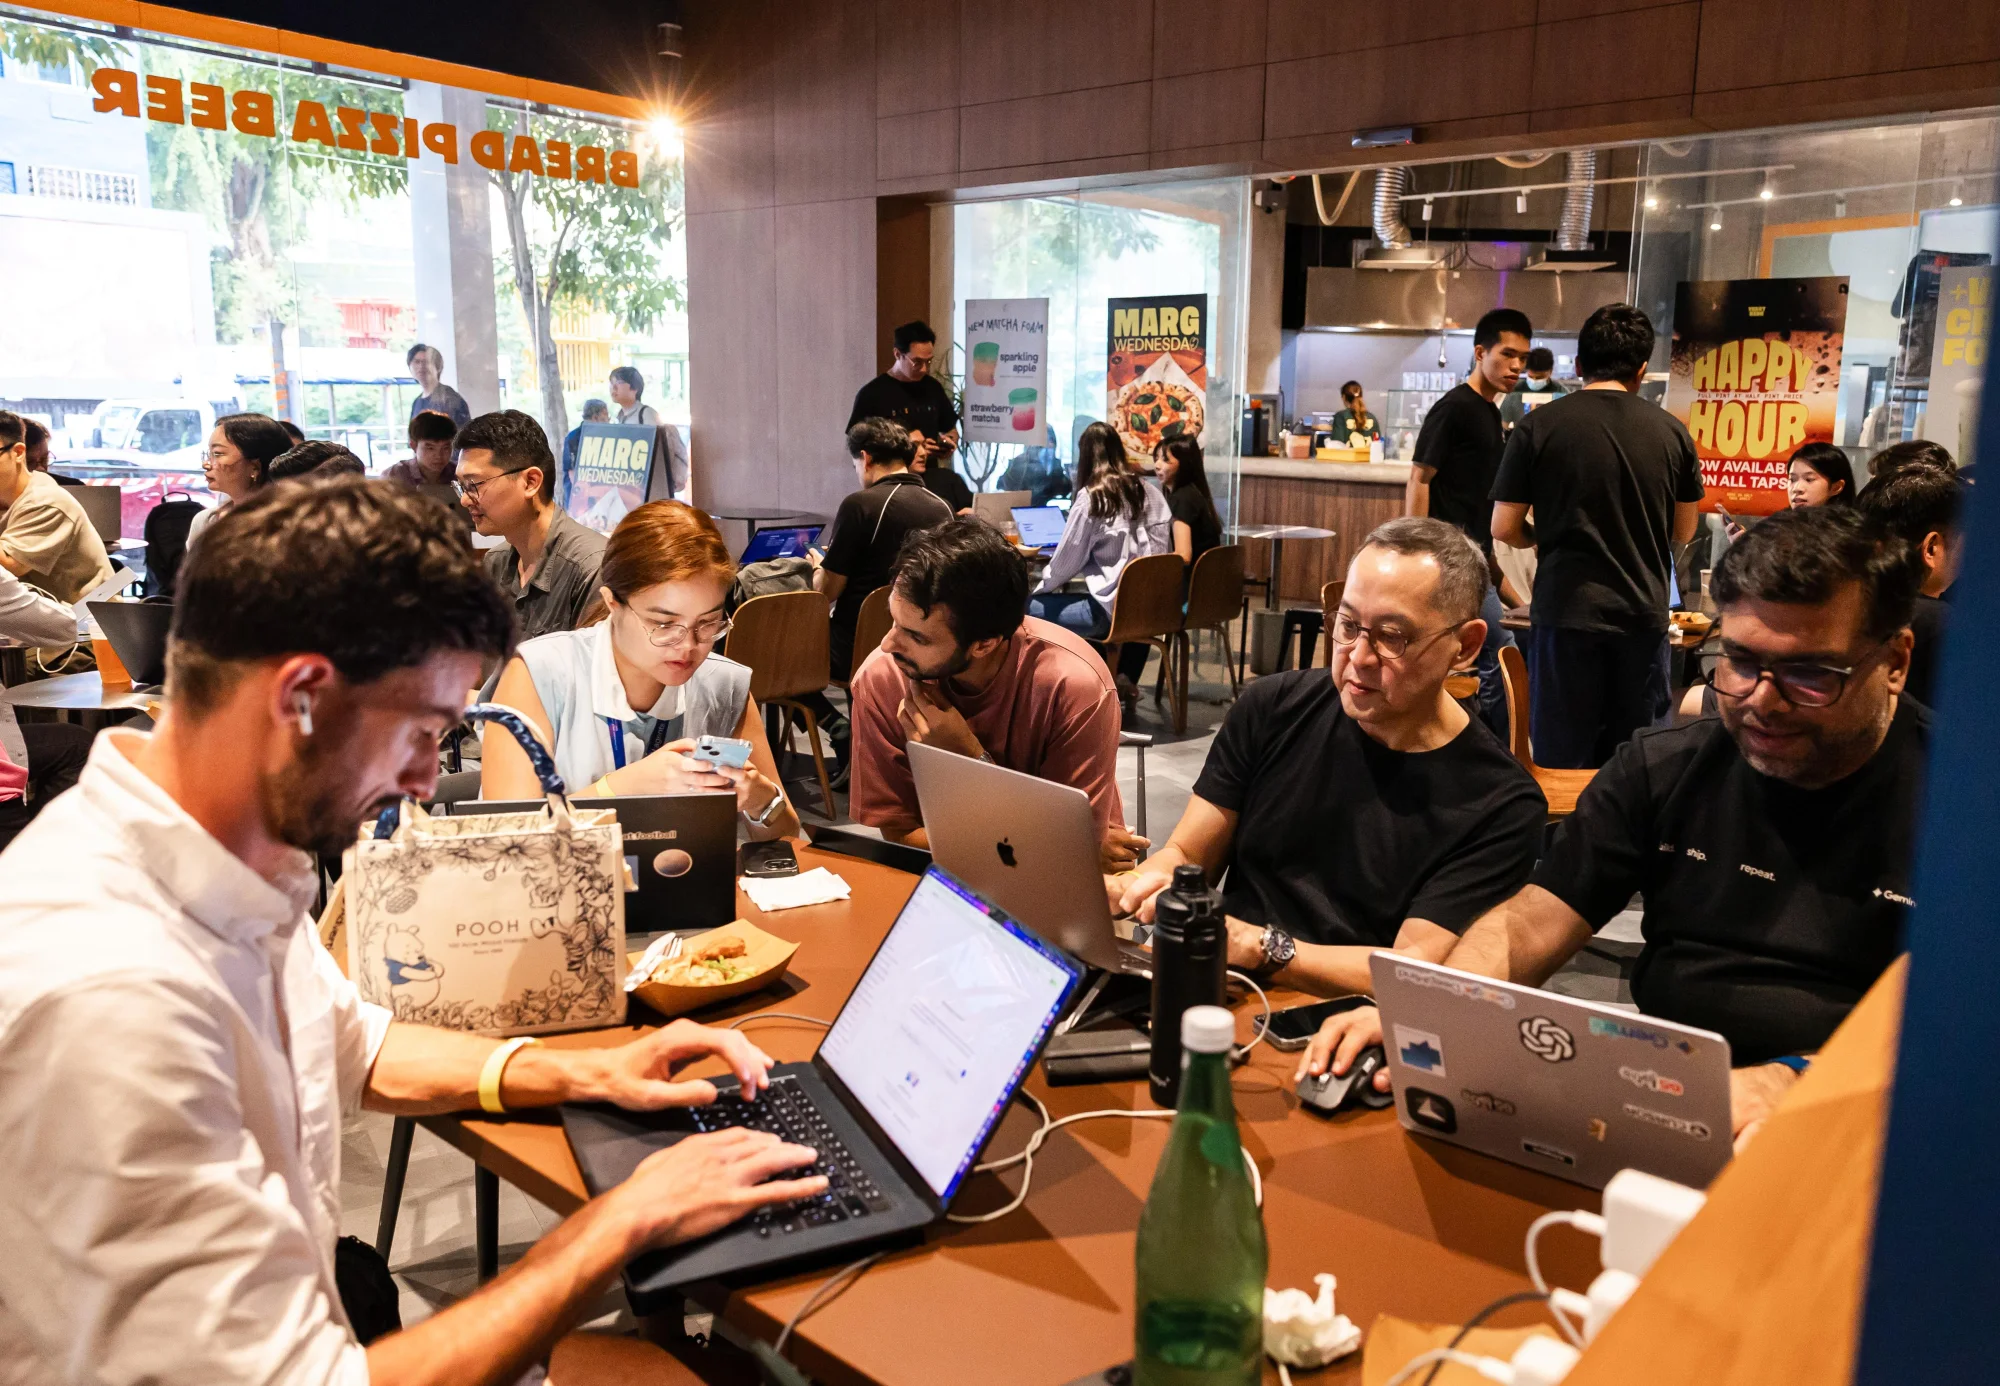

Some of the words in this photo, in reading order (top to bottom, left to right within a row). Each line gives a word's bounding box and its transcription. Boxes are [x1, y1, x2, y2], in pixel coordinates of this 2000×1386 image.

[968, 320, 984, 334] NEW
[986, 318, 1018, 332] MATCHA
[1021, 320, 1044, 333] FOAM
[1114, 306, 1200, 337] MARG
[1000, 352, 1039, 364] sparkling
[1692, 338, 1813, 392] HAPPY
[1013, 363, 1037, 374] apple
[970, 403, 1015, 415] strawberry
[971, 414, 1001, 423] matcha
[1688, 400, 1809, 459] HOUR
[579, 436, 649, 471] MARG
[1720, 475, 1747, 488] ALL
[1750, 476, 1788, 489] TAPS
[1686, 848, 1707, 861] ship.
[1740, 864, 1776, 881] repeat.
[1883, 890, 1917, 908] Gemin
[456, 920, 519, 937] POOH
